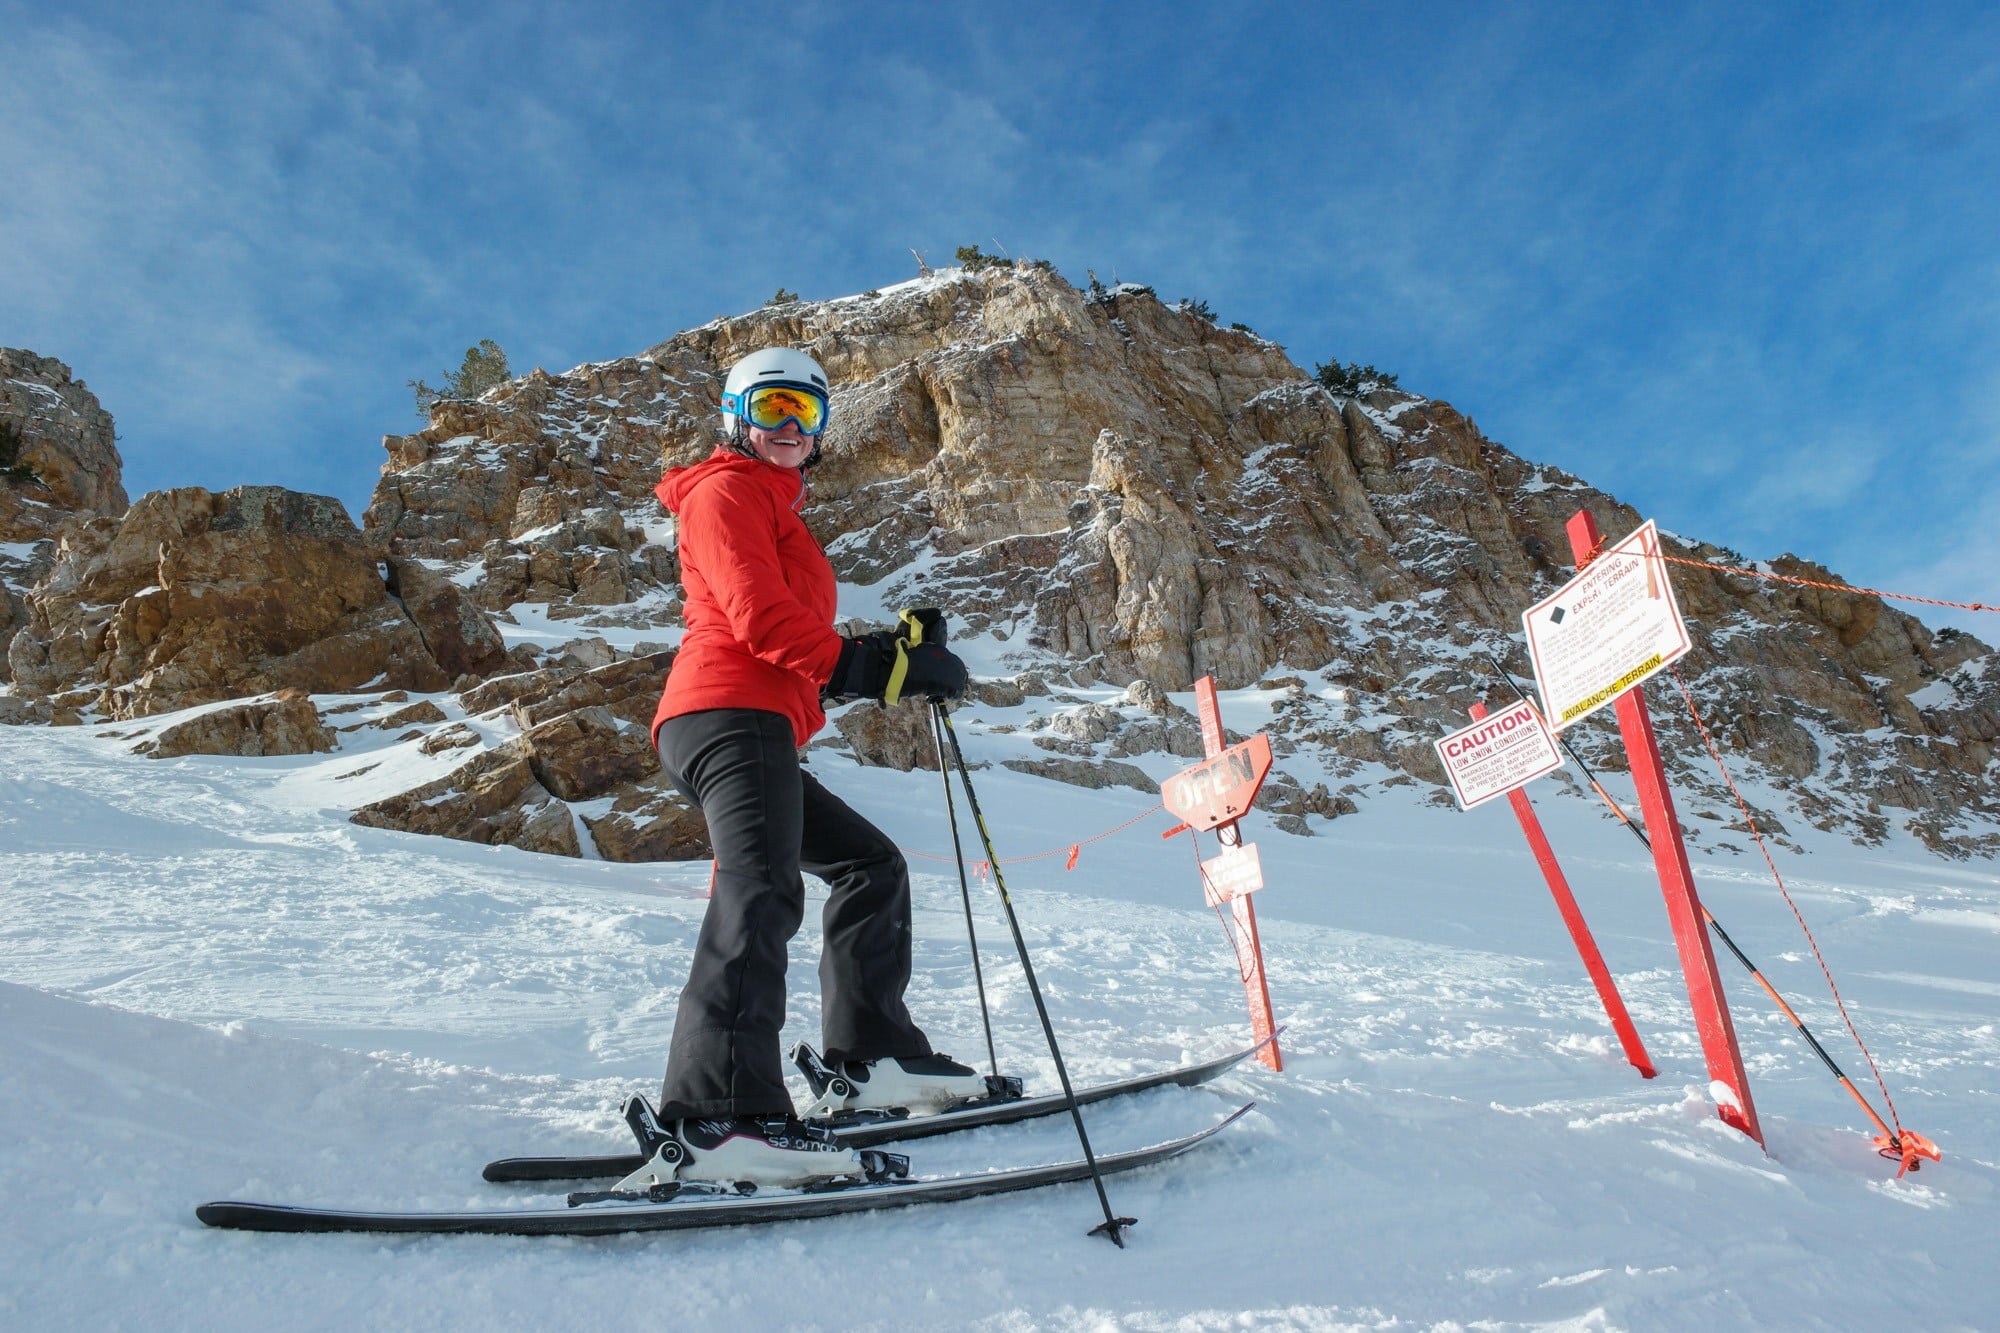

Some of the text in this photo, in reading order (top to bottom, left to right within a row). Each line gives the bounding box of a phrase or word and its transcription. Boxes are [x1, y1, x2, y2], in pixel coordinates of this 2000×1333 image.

[1571, 558, 1639, 614] EXPERT TERRAIN
[1582, 557, 1622, 593] ENTERING
[1564, 655, 1660, 720] AVALANCHE TERRAIN
[1447, 708, 1532, 757] CAUTION
[1452, 723, 1538, 769] LOW SNOW CONDITIONS
[1174, 747, 1255, 813] OPEN
[1460, 738, 1541, 779] MARKED AND UNMARKED
[1464, 749, 1550, 793] OR PRESENT THEMSELVES
[1467, 746, 1540, 784] OBSTACLES MAY EXIST
[1499, 767, 1529, 784] ANYTIME
